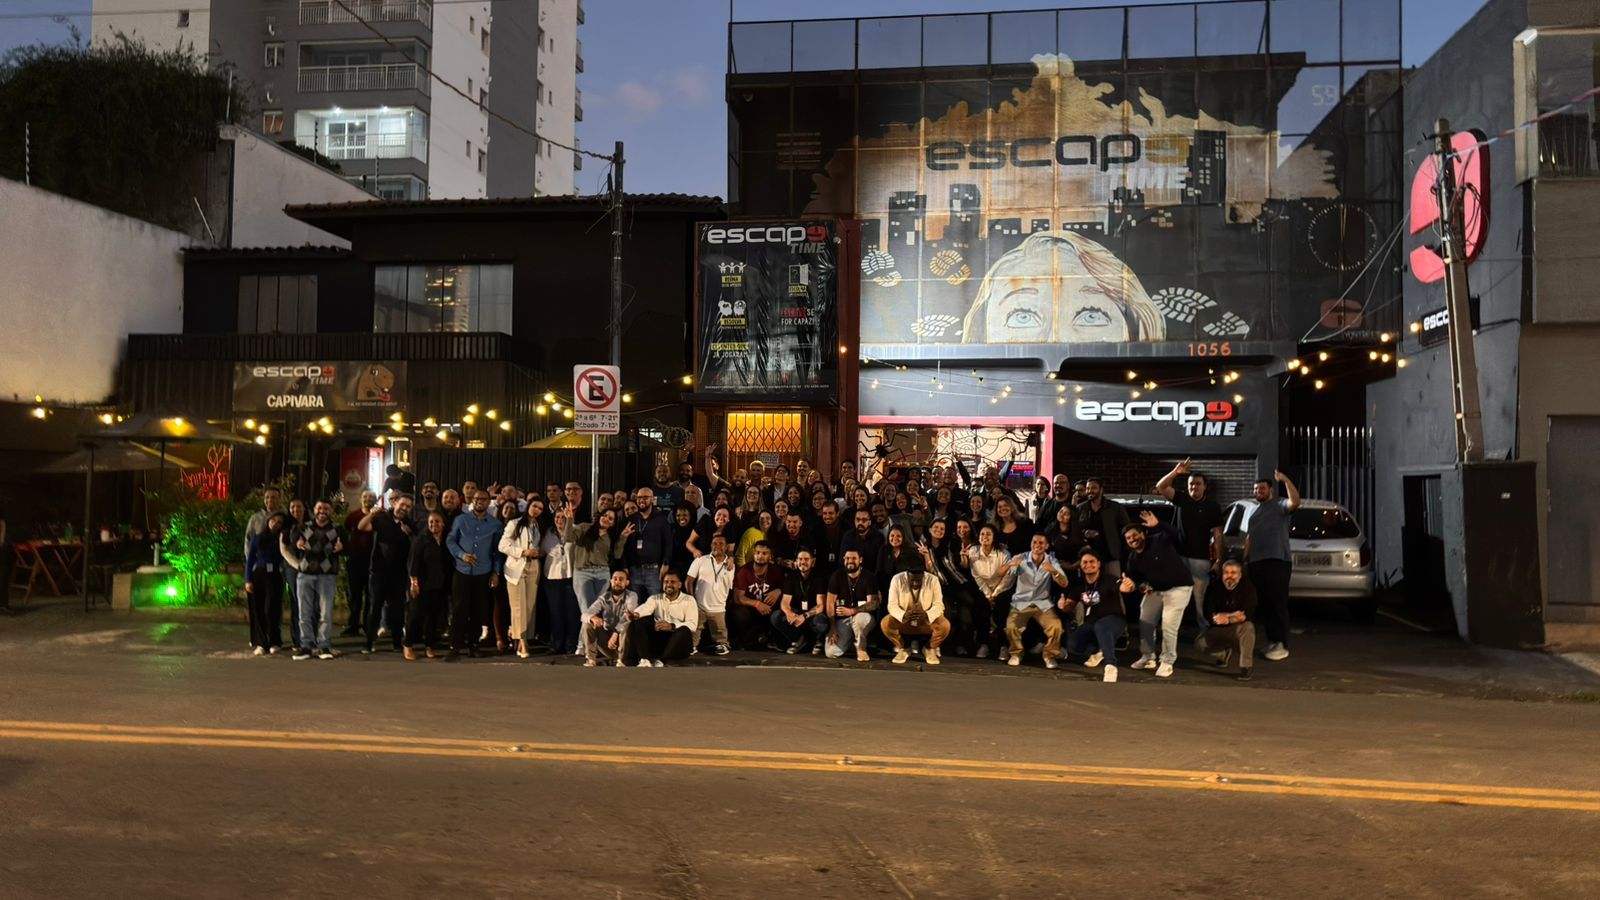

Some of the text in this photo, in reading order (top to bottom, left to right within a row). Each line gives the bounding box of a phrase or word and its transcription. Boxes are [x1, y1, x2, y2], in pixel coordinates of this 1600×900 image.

[790, 242, 826, 254] TIME
[781, 317, 792, 326] FOR
[1188, 342, 1231, 357] 1056
[310, 377, 334, 385] TIME
[267, 394, 324, 408] CAPIVARA
[1183, 421, 1238, 437] TIME
